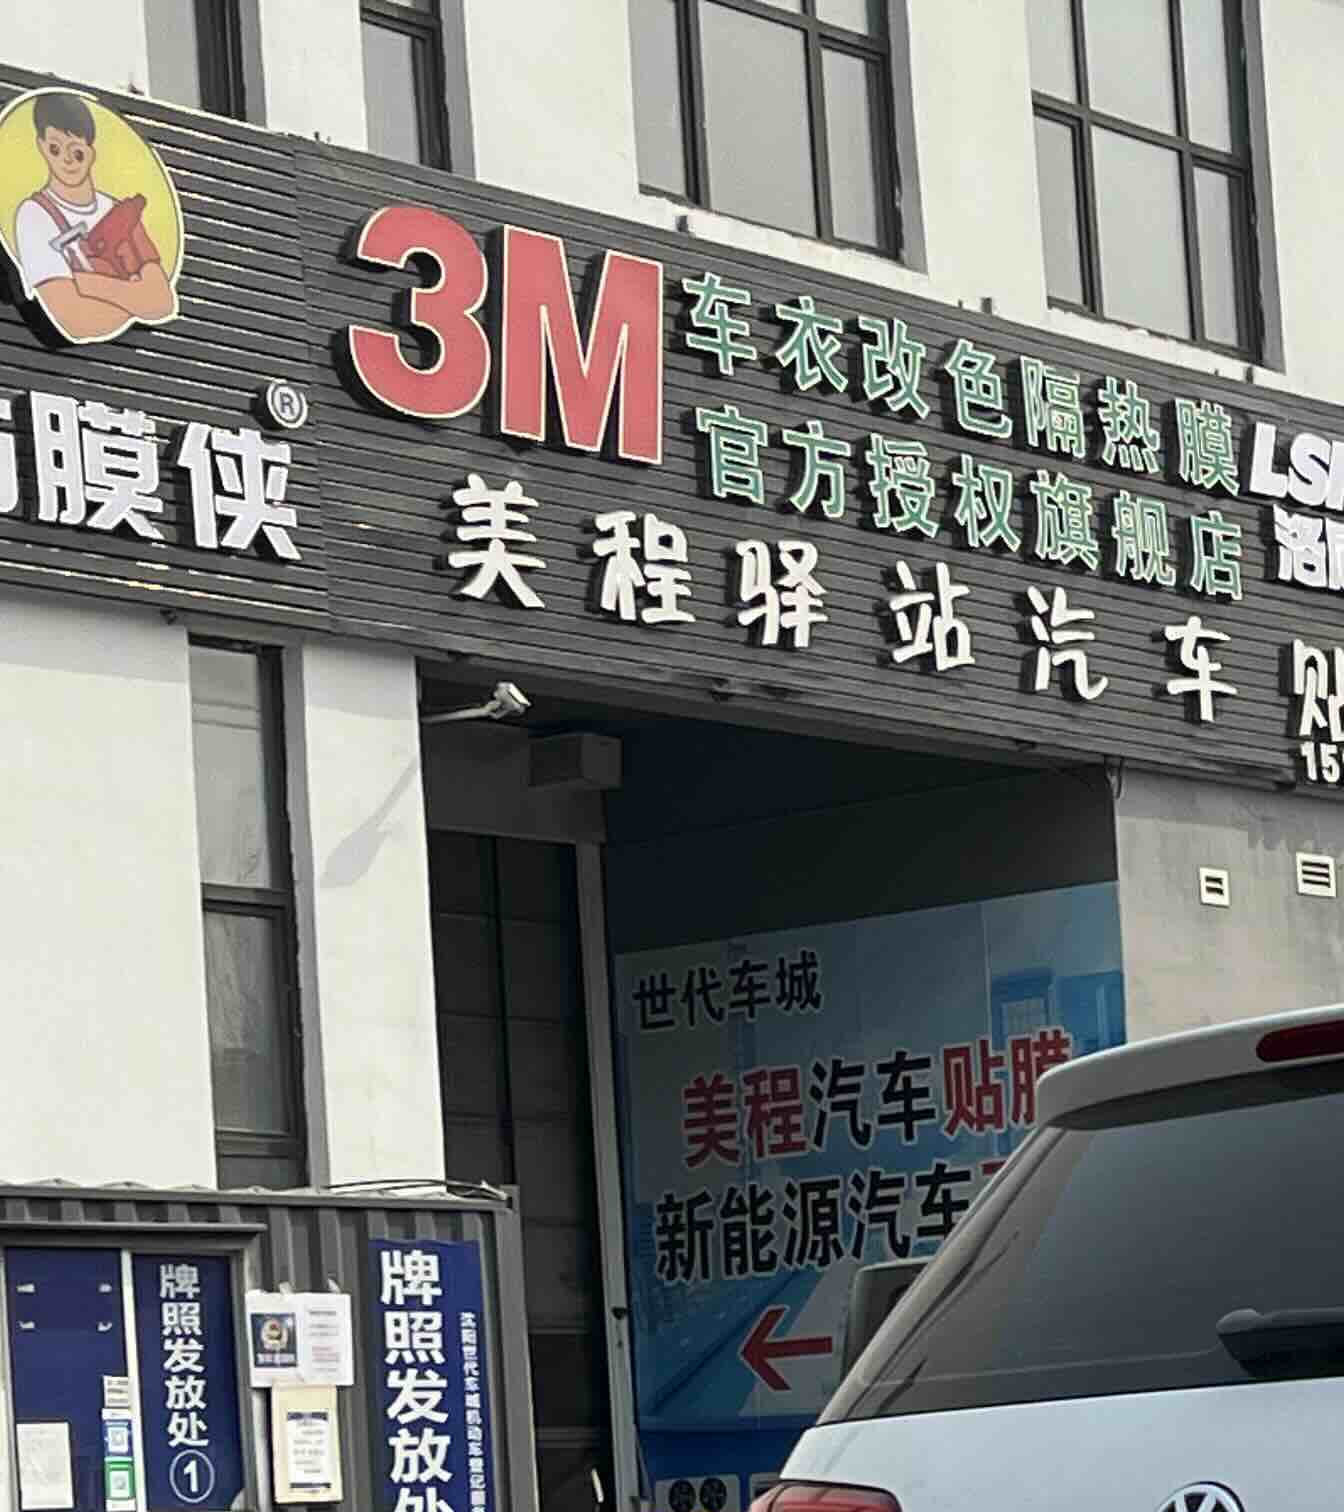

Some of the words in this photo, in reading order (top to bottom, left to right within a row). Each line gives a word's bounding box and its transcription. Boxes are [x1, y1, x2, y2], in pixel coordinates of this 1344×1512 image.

[348, 203, 664, 466] 3M
[681, 271, 1243, 498] 车衣改色隔热膜
[0, 386, 302, 561] 膜侠
[695, 404, 1246, 600] 官方授权旗舰店
[632, 950, 823, 1032] 世代车城
[654, 1158, 1006, 1283] 新能源汽车
[159, 1263, 210, 1449] 牌照发放处
